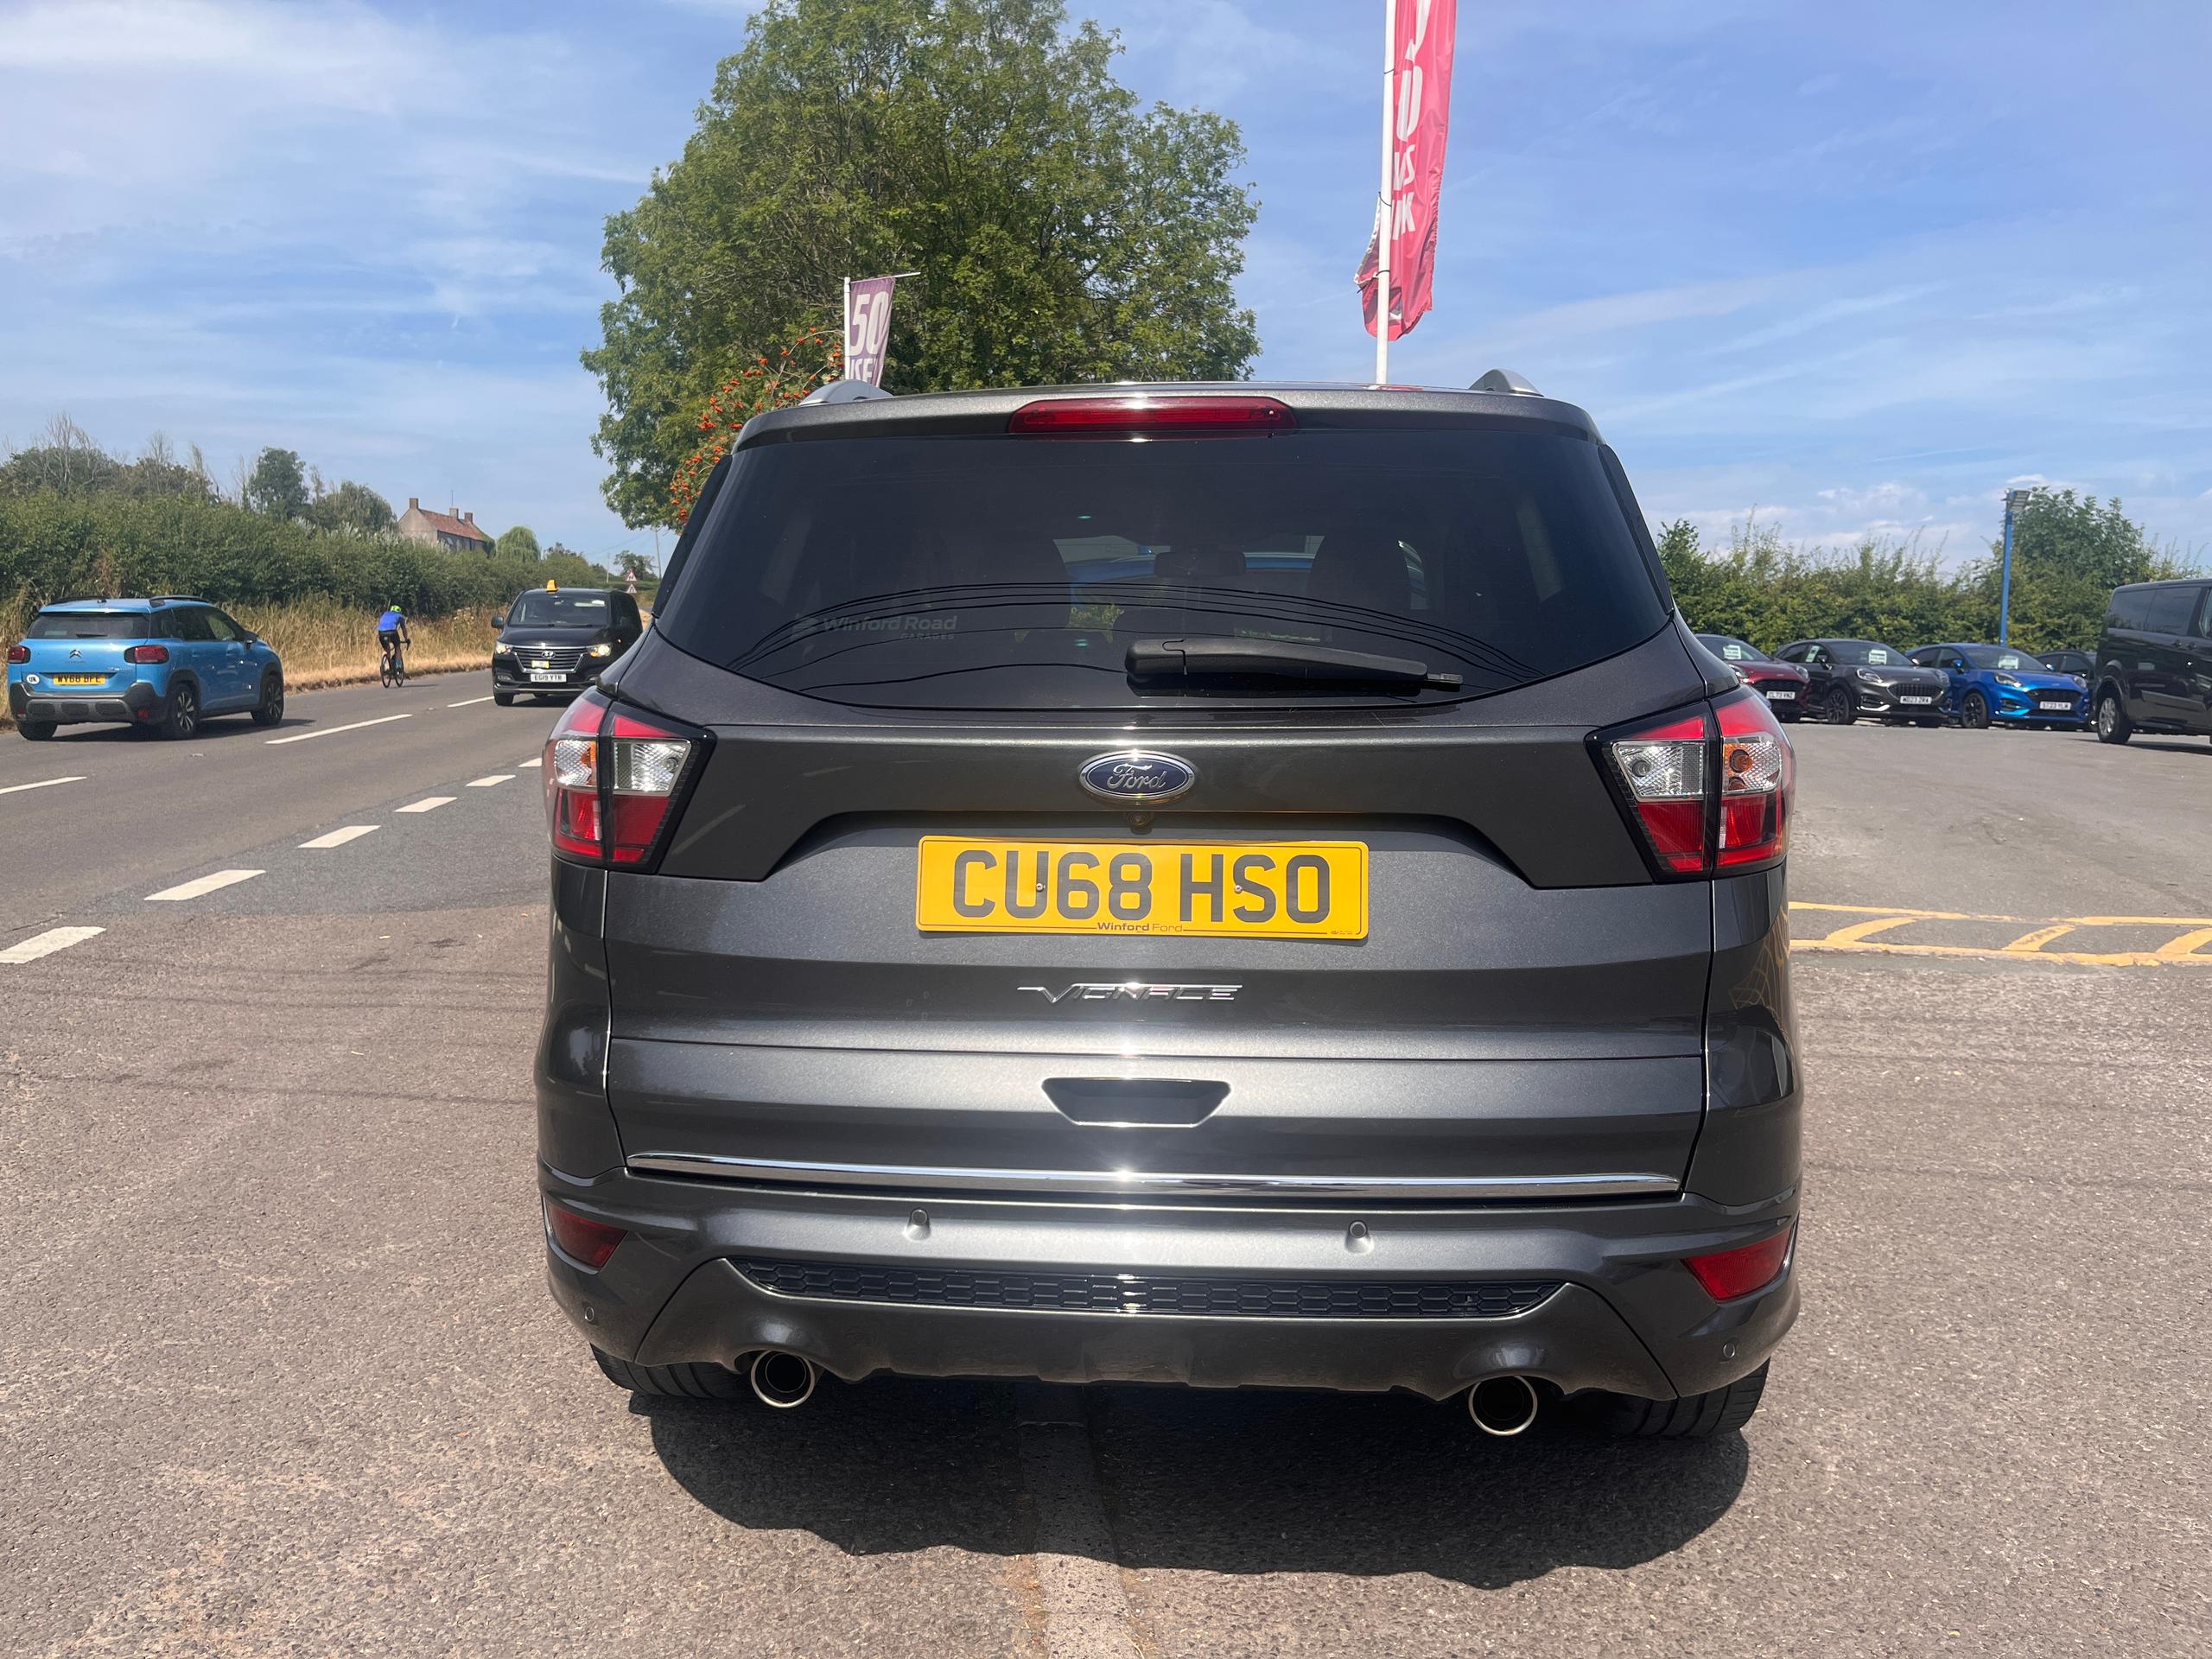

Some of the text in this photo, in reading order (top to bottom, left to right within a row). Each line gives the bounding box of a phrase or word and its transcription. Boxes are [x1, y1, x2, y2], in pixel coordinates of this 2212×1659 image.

[824, 615, 957, 632] Winford Road
[1106, 763, 1167, 789] Ford
[953, 849, 1331, 924] CU68 HSO
[1097, 922, 1183, 932] Winford Ford
[1018, 982, 1243, 1003] VIGNALE
